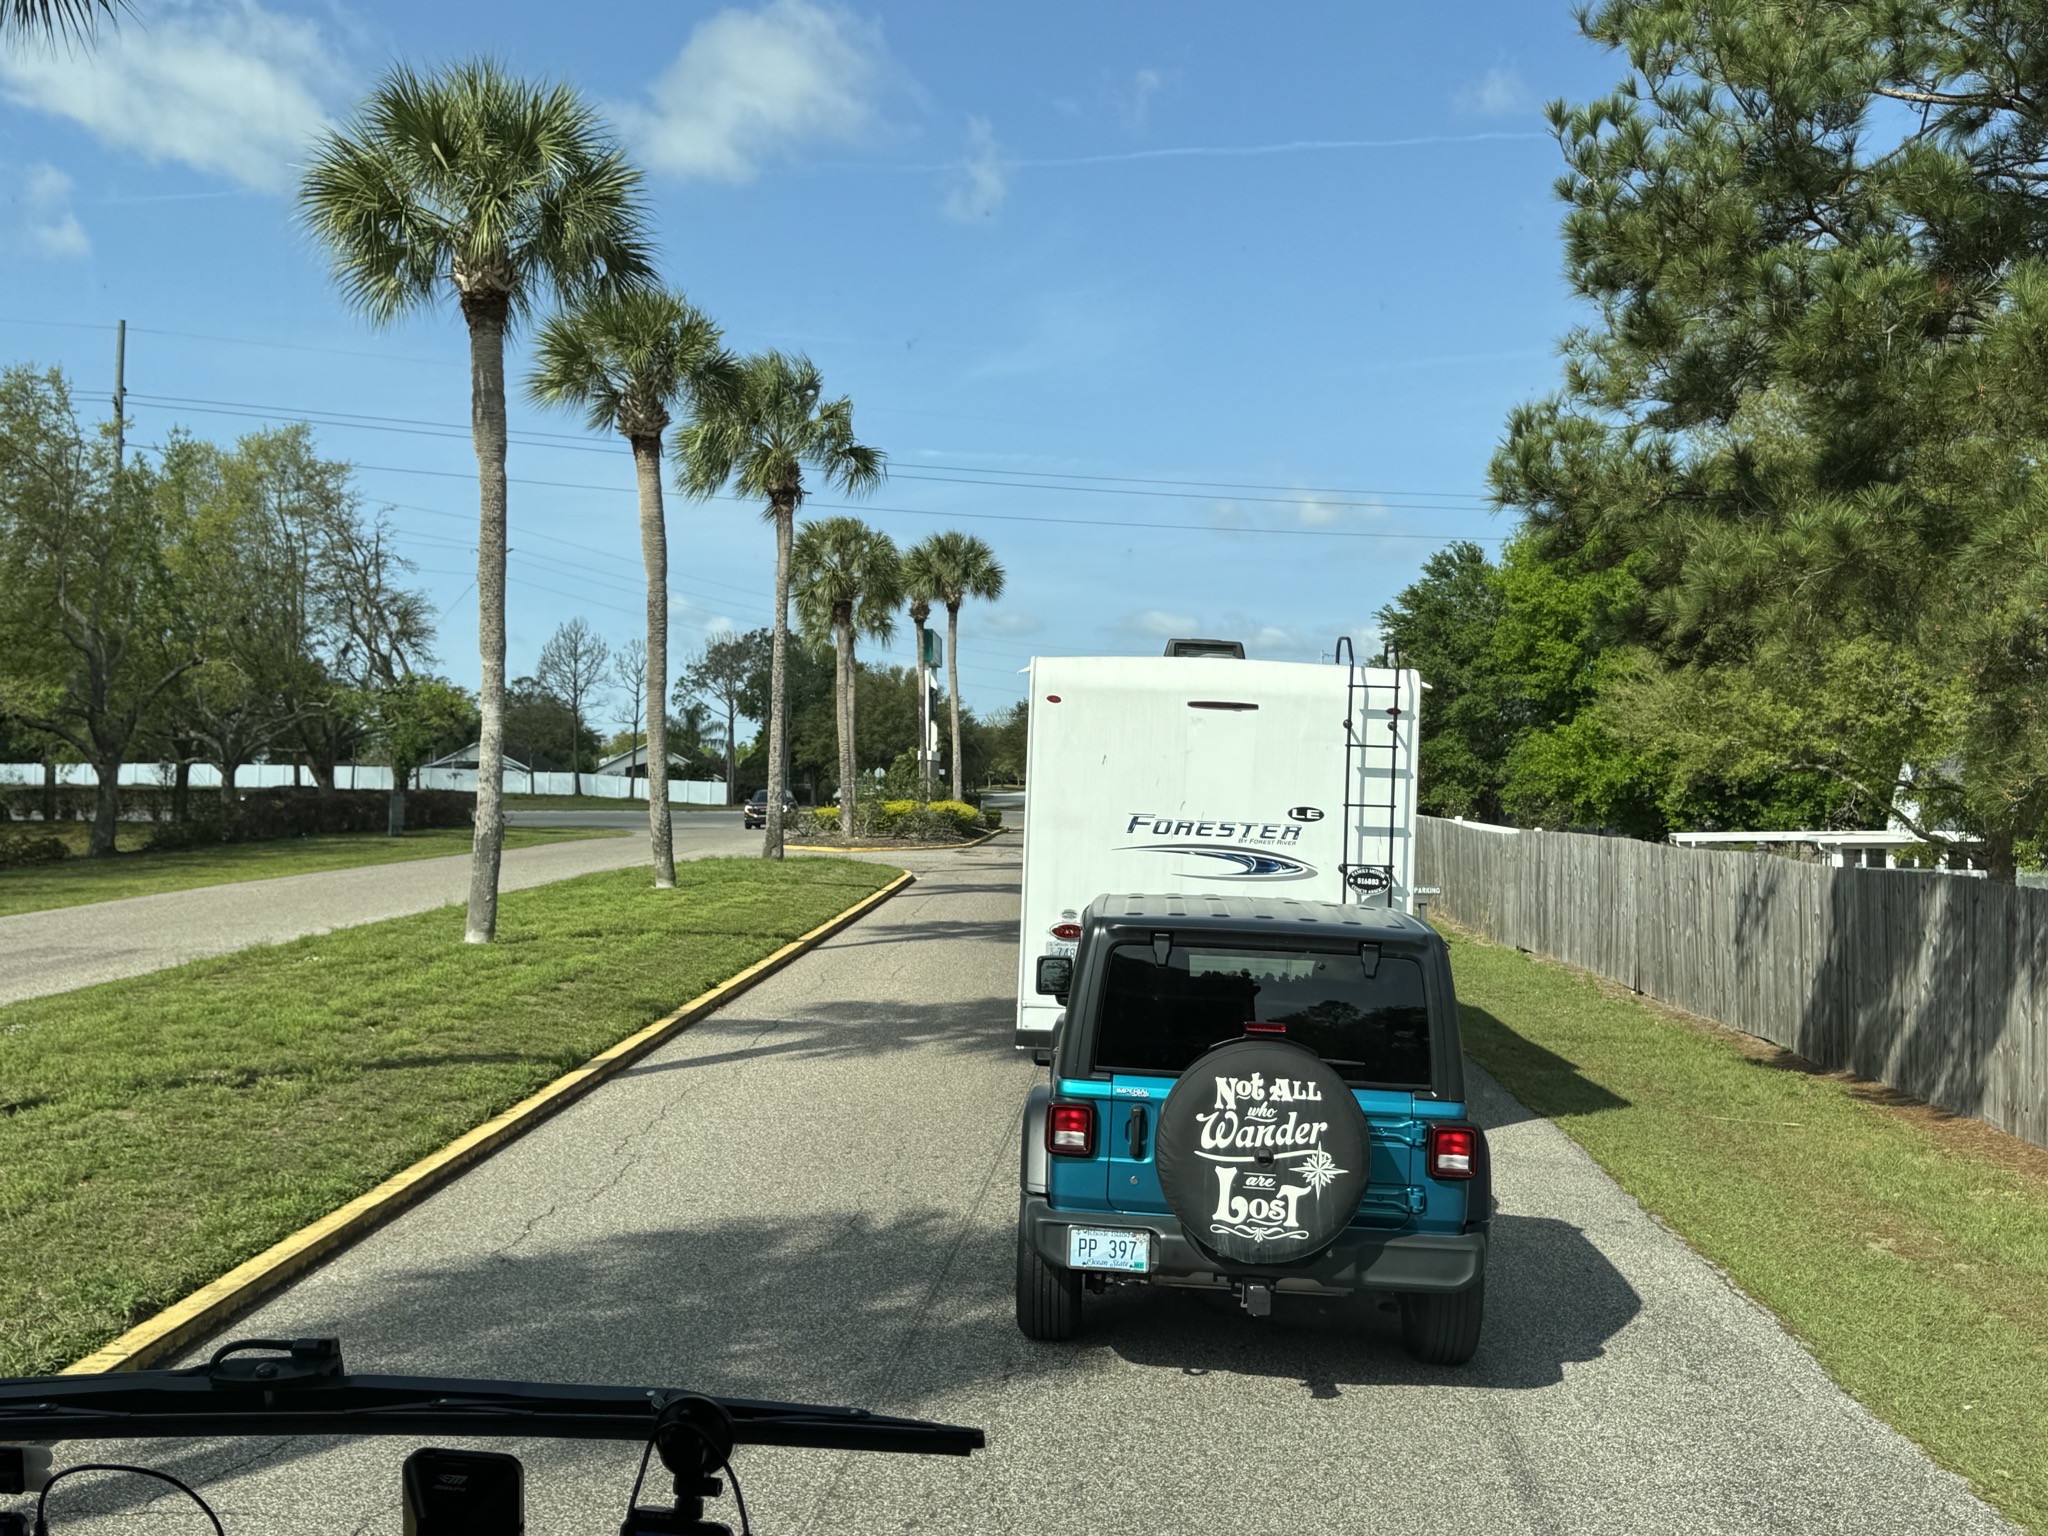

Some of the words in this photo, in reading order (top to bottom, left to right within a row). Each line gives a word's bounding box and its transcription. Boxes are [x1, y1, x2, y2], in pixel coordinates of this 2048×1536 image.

[1291, 808, 1320, 819] LE
[1126, 812, 1303, 841] FORESTER
[1414, 886, 1441, 894] PARKING
[1214, 1072, 1265, 1110] Not
[1269, 1078, 1322, 1102] ALL
[1247, 1101, 1278, 1119] who
[1195, 1110, 1328, 1149] Wander
[1245, 1175, 1276, 1187] are
[1078, 1238, 1097, 1257] PP
[1109, 1240, 1137, 1260] 397
[1086, 1258, 1108, 1266] Ocean
[1110, 1260, 1129, 1268] State
